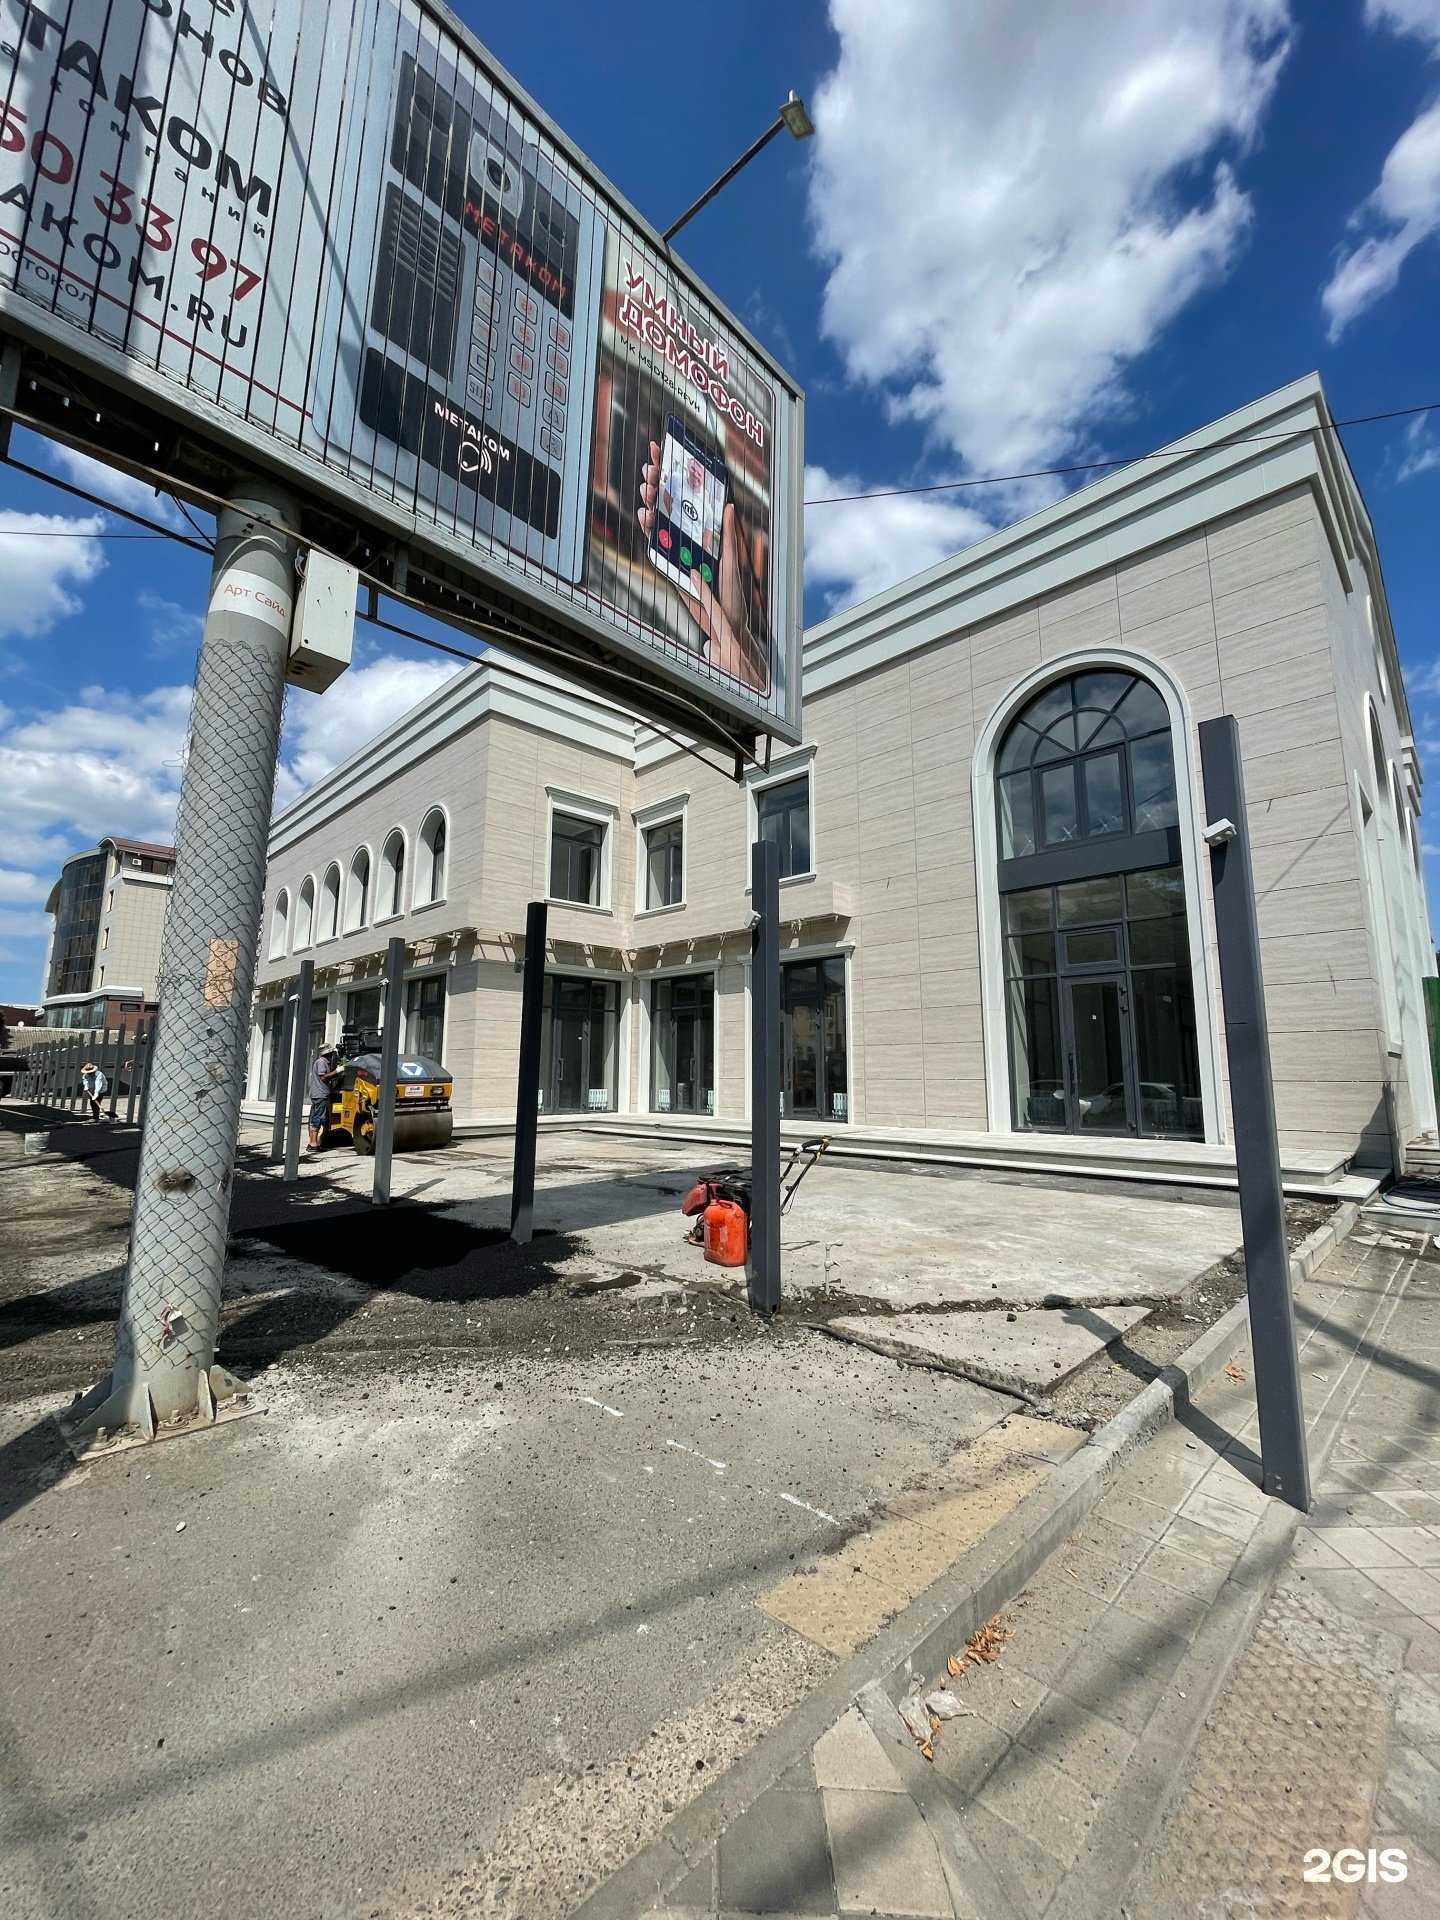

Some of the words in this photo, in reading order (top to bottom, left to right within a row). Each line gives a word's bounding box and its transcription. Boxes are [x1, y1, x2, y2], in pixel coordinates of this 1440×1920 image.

[50, 75, 265, 239] компаний
[93, 170, 175, 251] 33
[191, 238, 262, 300] 97
[618, 294, 764, 448] ДОМОФОН
[623, 256, 730, 384] УМНЫЙ
[224, 584, 251, 597] Арт
[255, 591, 286, 617] Сайд
